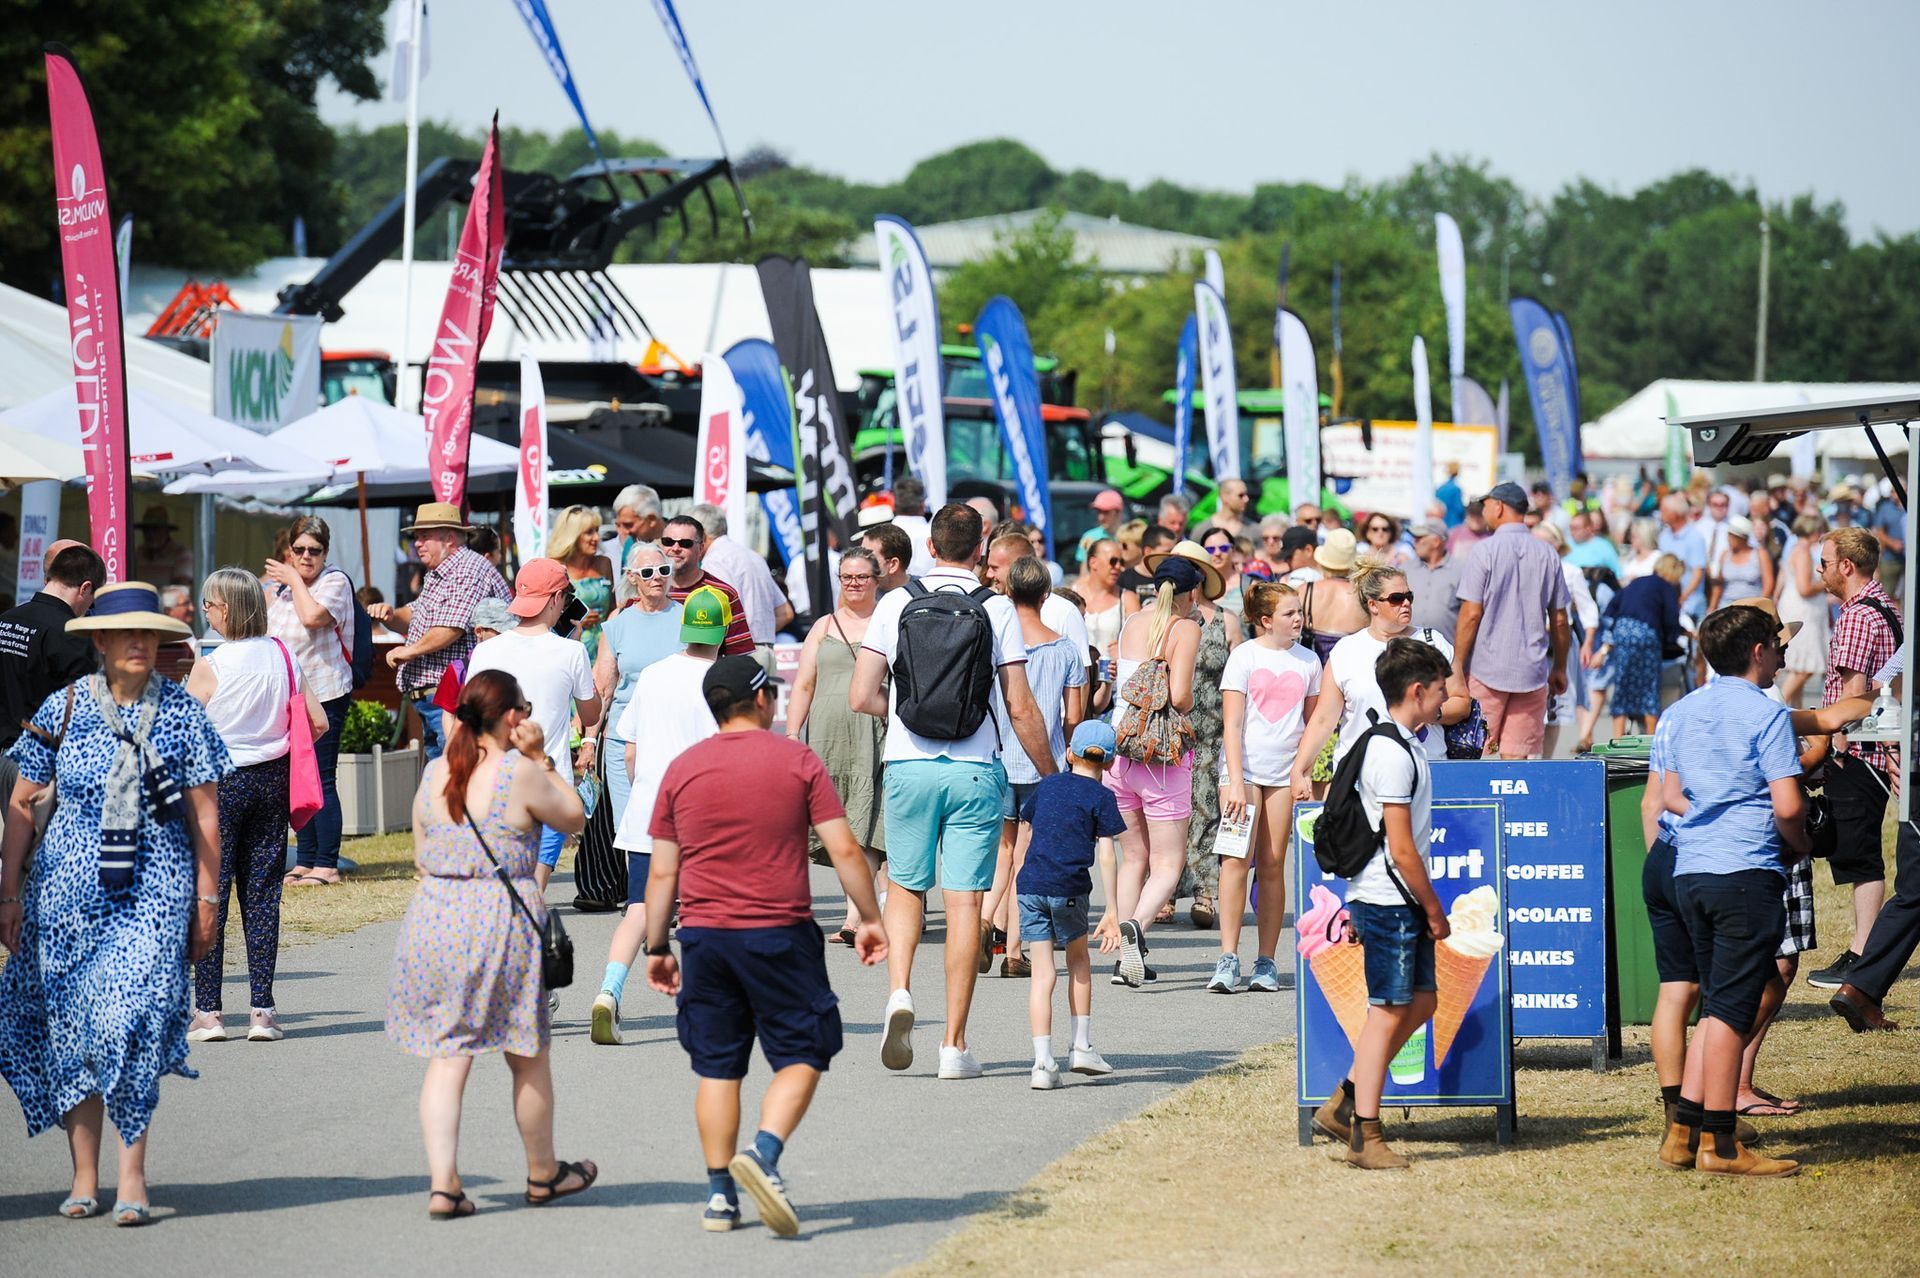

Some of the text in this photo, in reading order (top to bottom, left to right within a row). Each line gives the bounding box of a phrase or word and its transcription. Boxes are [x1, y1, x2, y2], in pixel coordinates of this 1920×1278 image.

[1490, 779, 1529, 795] TEA
[1428, 848, 1485, 880] urt
[1506, 864, 1584, 880] COFFEE
[1508, 907, 1593, 923] OCOLATE
[1508, 950, 1575, 966] HAKES
[1512, 993, 1578, 1009] RINKS
